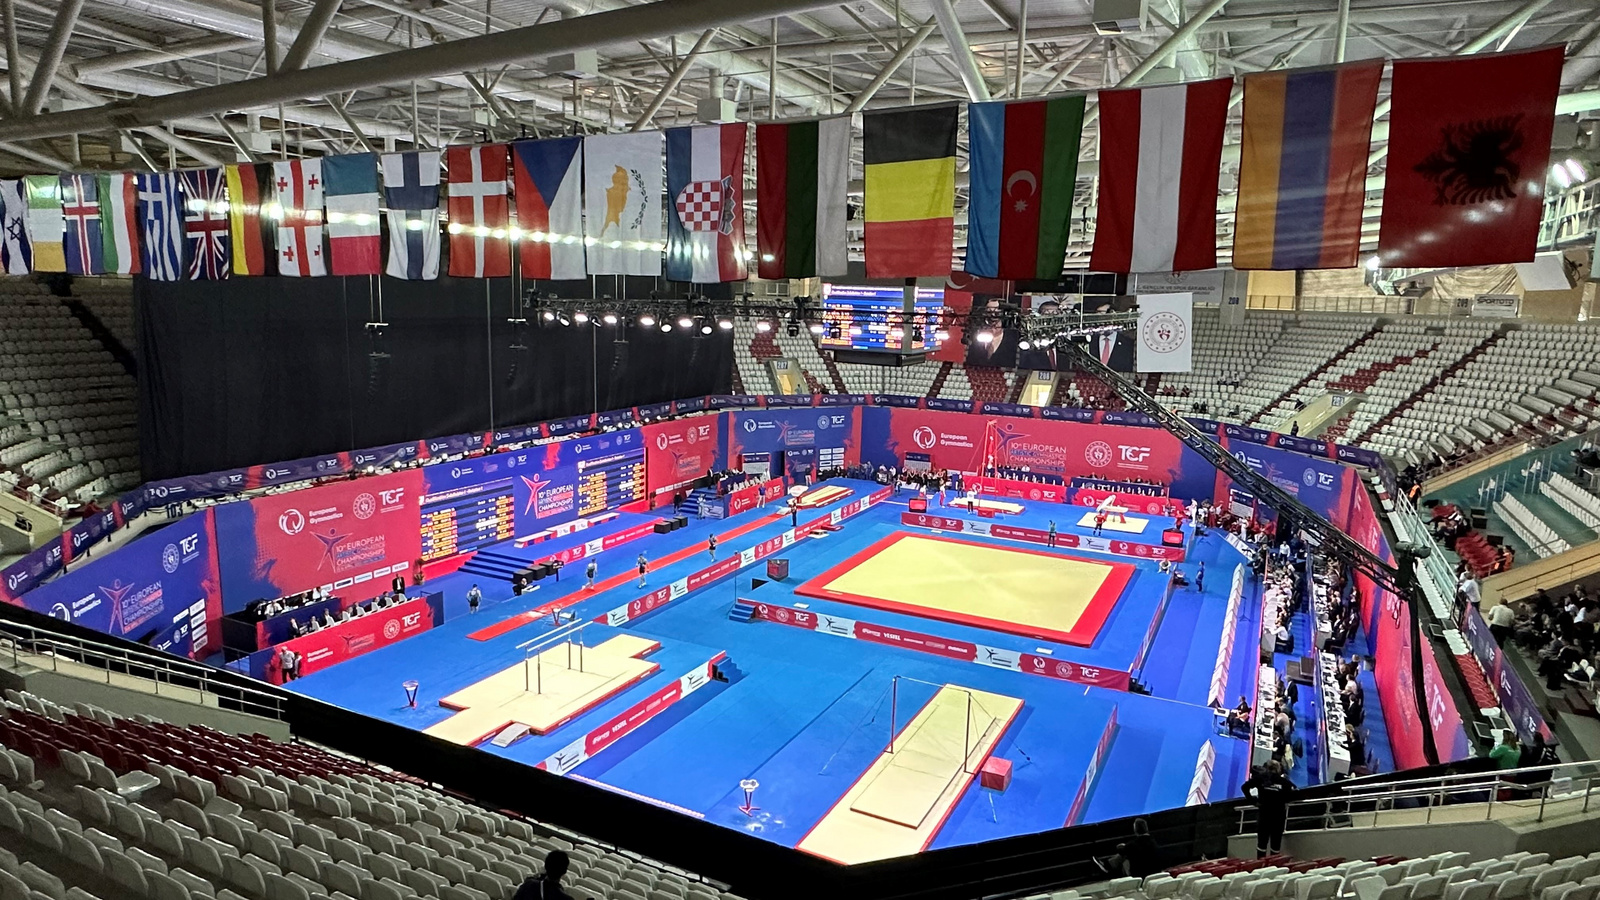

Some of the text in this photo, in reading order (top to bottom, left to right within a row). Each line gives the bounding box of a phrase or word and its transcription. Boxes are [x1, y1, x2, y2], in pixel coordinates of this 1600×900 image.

[940, 432, 968, 441] European
[940, 439, 974, 448] Gymnastics
[1022, 442, 1067, 454] EUROPEAN
[1117, 444, 1151, 462] TCF
[1010, 455, 1066, 467] CHAMPIONSHIPS
[1318, 472, 1334, 486] TCF
[378, 487, 405, 506] TCF
[546, 484, 574, 497] EUROPEAN
[166, 503, 183, 518] 103
[309, 506, 337, 518] European
[538, 499, 574, 512] CHAMPIONSHIPS
[309, 512, 343, 525] Gymnastics
[179, 533, 199, 556] TCF
[346, 534, 385, 551] EUROPEAN
[336, 548, 386, 566] CHAMPIONSHIPS
[130, 580, 162, 605] EUROPEAN
[402, 611, 421, 626] TCF
[794, 611, 810, 622] TCF
[1080, 666, 1099, 679] TCF
